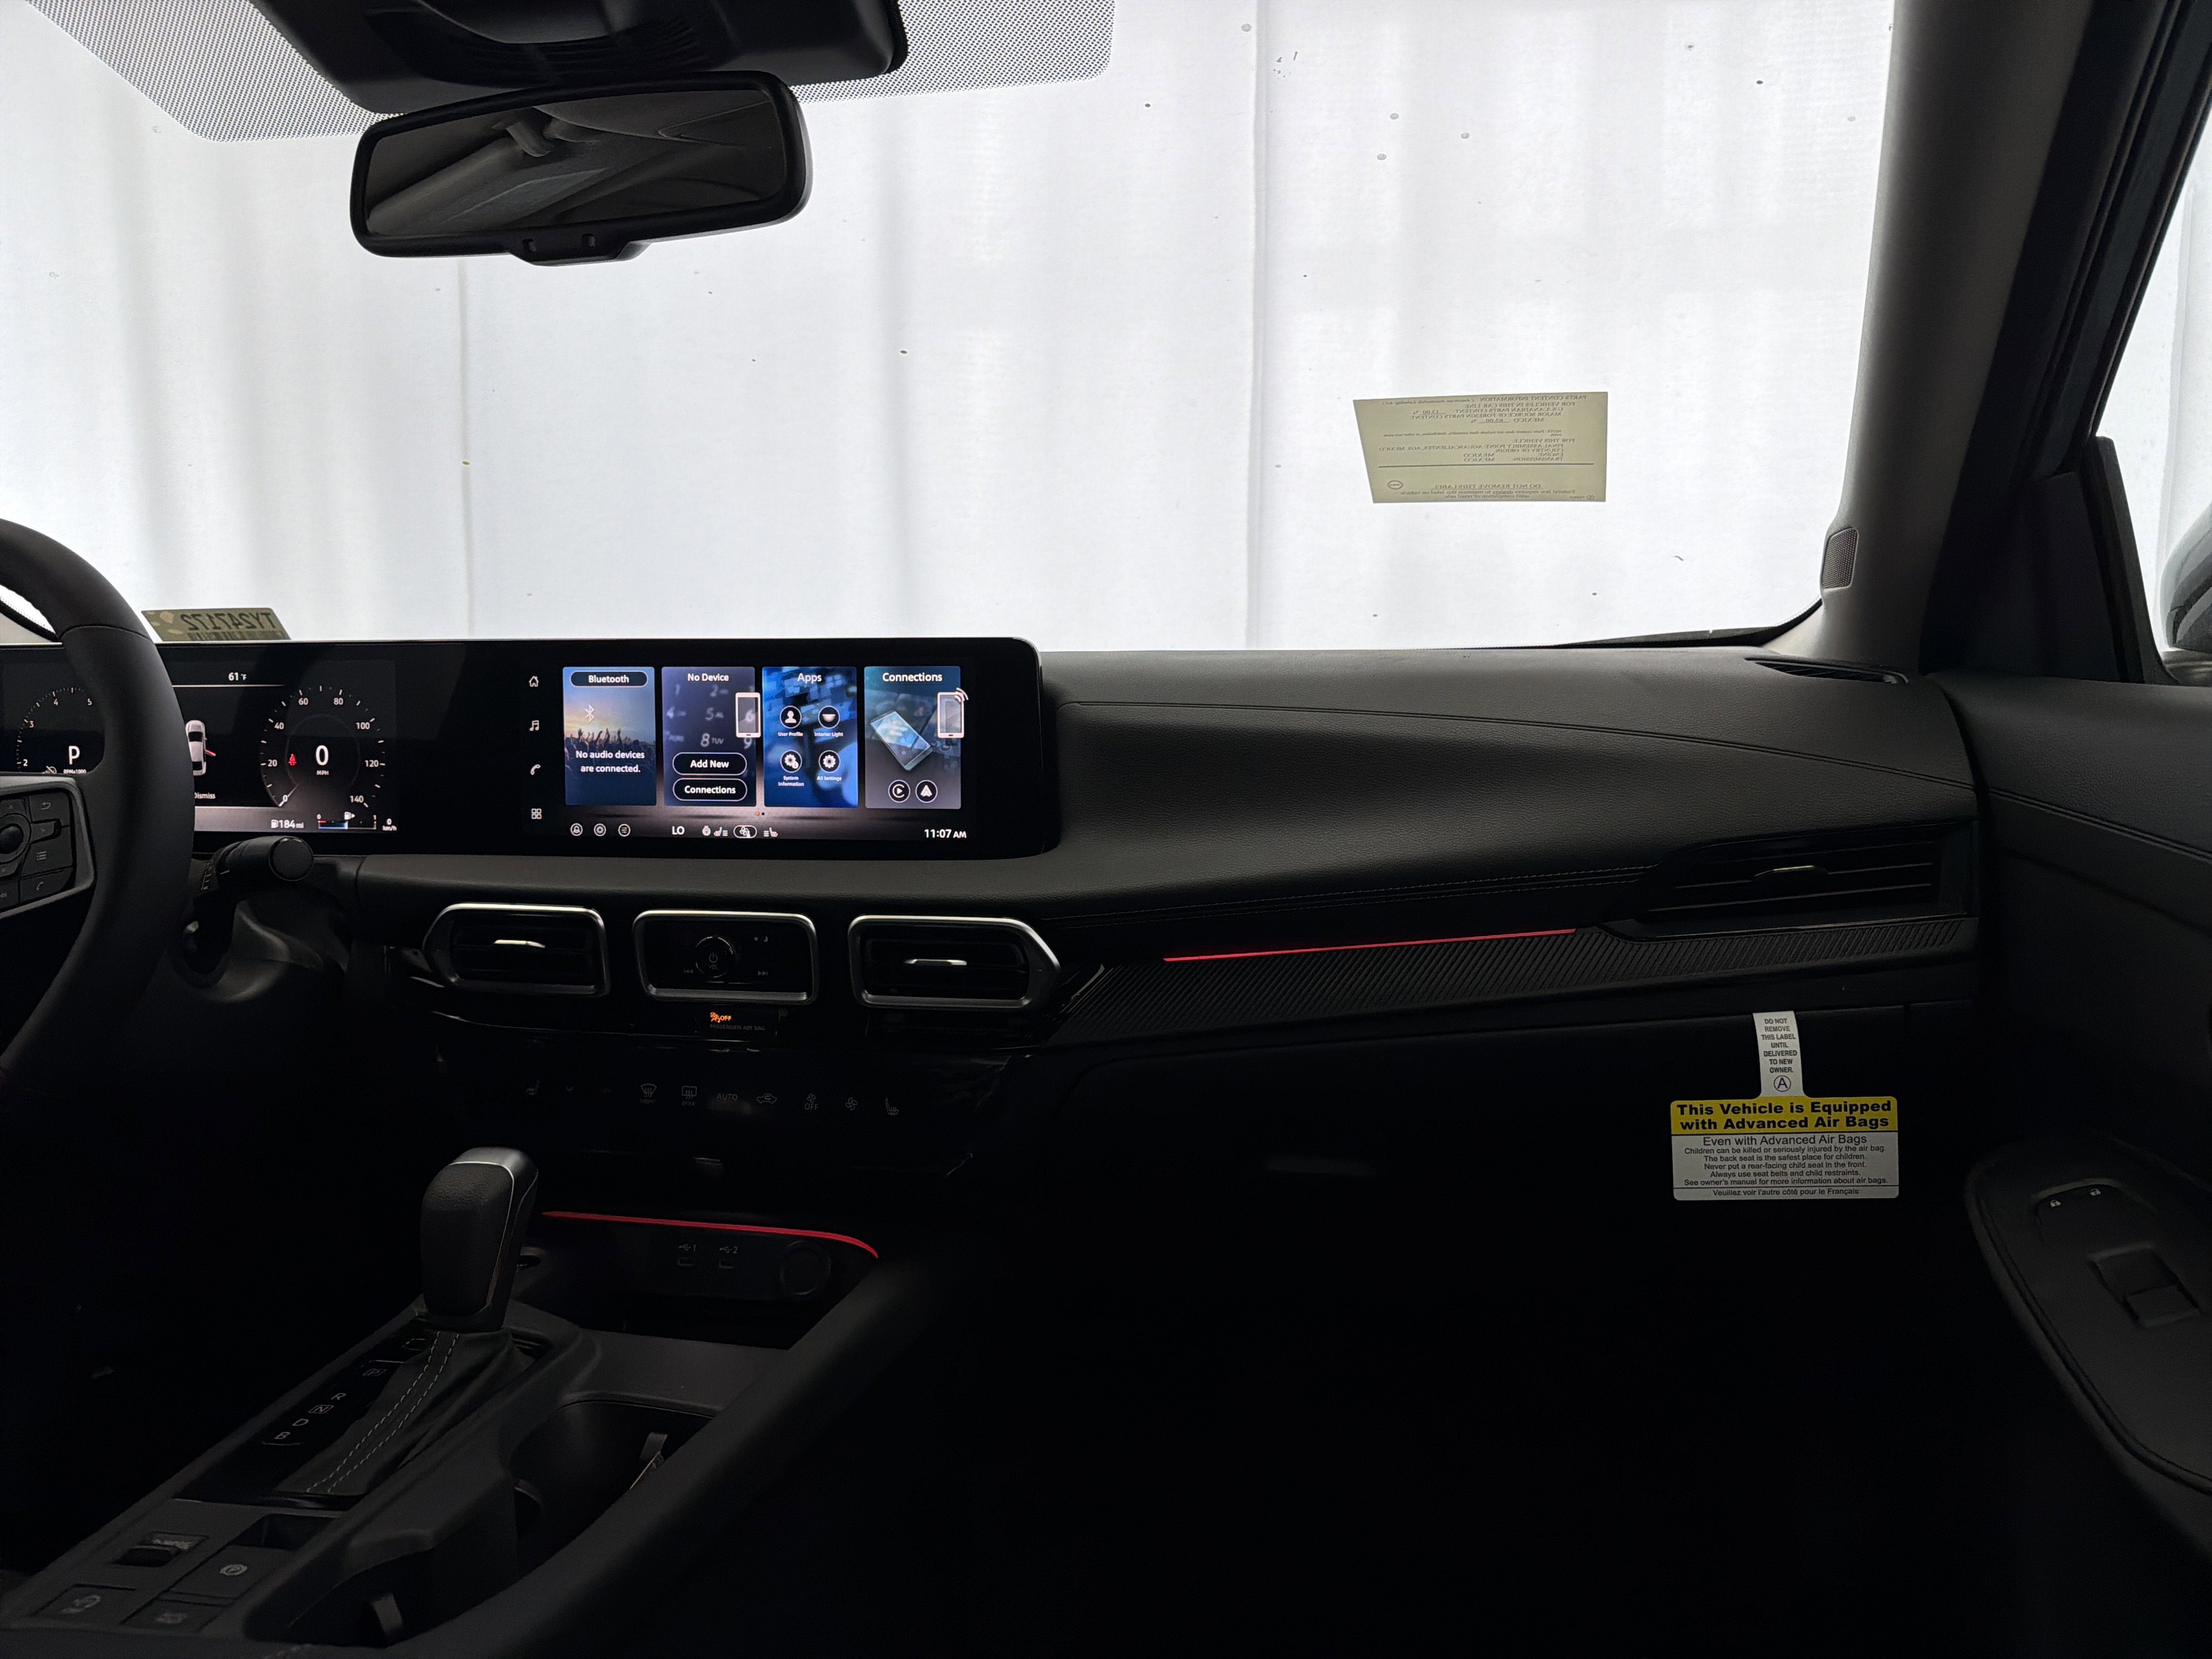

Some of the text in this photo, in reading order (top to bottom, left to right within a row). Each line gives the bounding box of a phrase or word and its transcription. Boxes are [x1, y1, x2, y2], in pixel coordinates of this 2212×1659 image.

[228, 673, 239, 681] 61
[588, 675, 629, 683] Bluetooth
[687, 673, 729, 681] No Device
[797, 673, 822, 684] Apps
[882, 672, 943, 682] Connections
[701, 733, 710, 747] 8
[69, 746, 80, 765] P
[315, 745, 329, 765] 0
[615, 751, 645, 759] devices
[690, 760, 729, 768] Add New
[685, 786, 736, 794] Connections
[279, 820, 296, 828] 184
[672, 826, 684, 834] LO
[924, 829, 951, 838] 11:07
[1778, 1077, 1788, 1088] A
[1677, 1101, 1891, 1115] This Vehicle is Equipped
[1680, 1116, 1889, 1130] with Advanced Air Bags
[1703, 1134, 1867, 1146] Even with Advanced Air Bags
